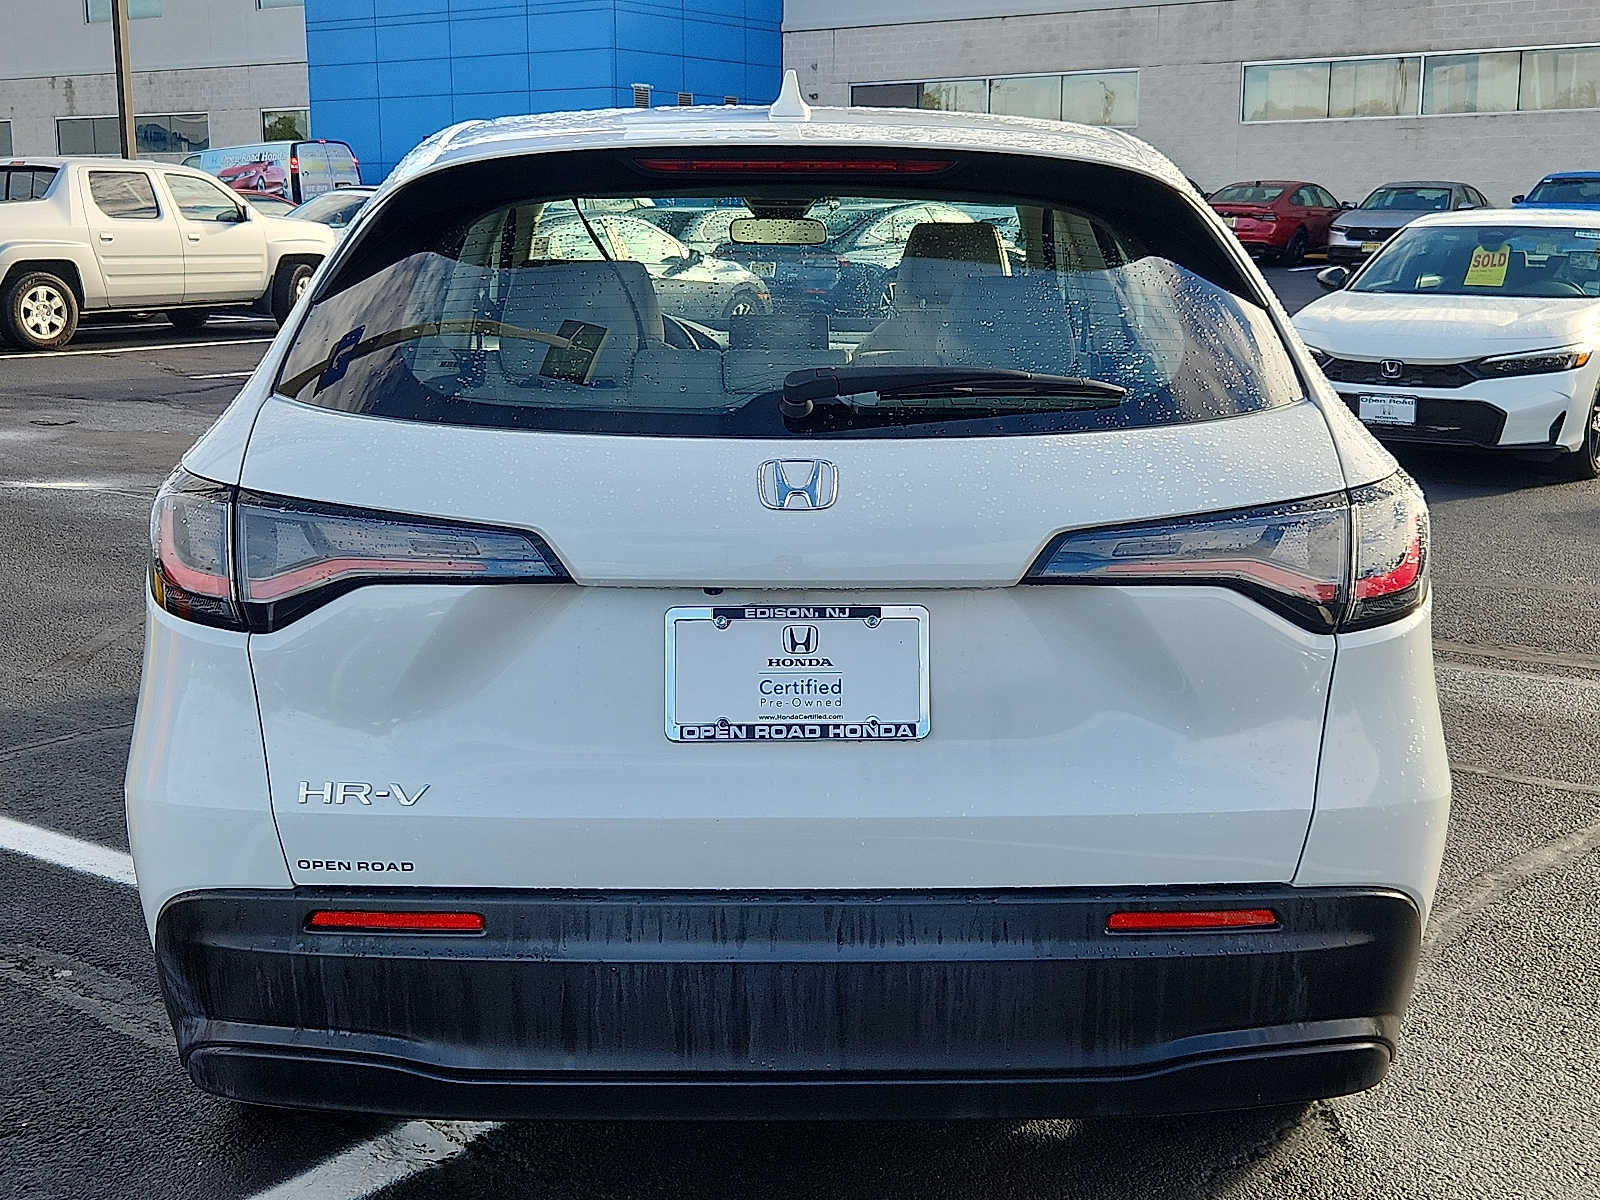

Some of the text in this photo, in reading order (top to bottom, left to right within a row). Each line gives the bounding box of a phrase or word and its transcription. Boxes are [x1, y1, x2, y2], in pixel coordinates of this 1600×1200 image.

[241, 152, 260, 162] Road
[1472, 252, 1507, 268] SOLD
[1389, 398, 1414, 406] Road
[744, 608, 850, 619] EDISON, NJ
[767, 658, 833, 667] HONDA
[759, 678, 842, 695] Certified
[760, 697, 842, 708] Pre-Owned
[682, 724, 914, 739] OPEN ROAD HONDA
[297, 780, 431, 807] HR-V
[297, 859, 414, 872] OPEN ROAD
